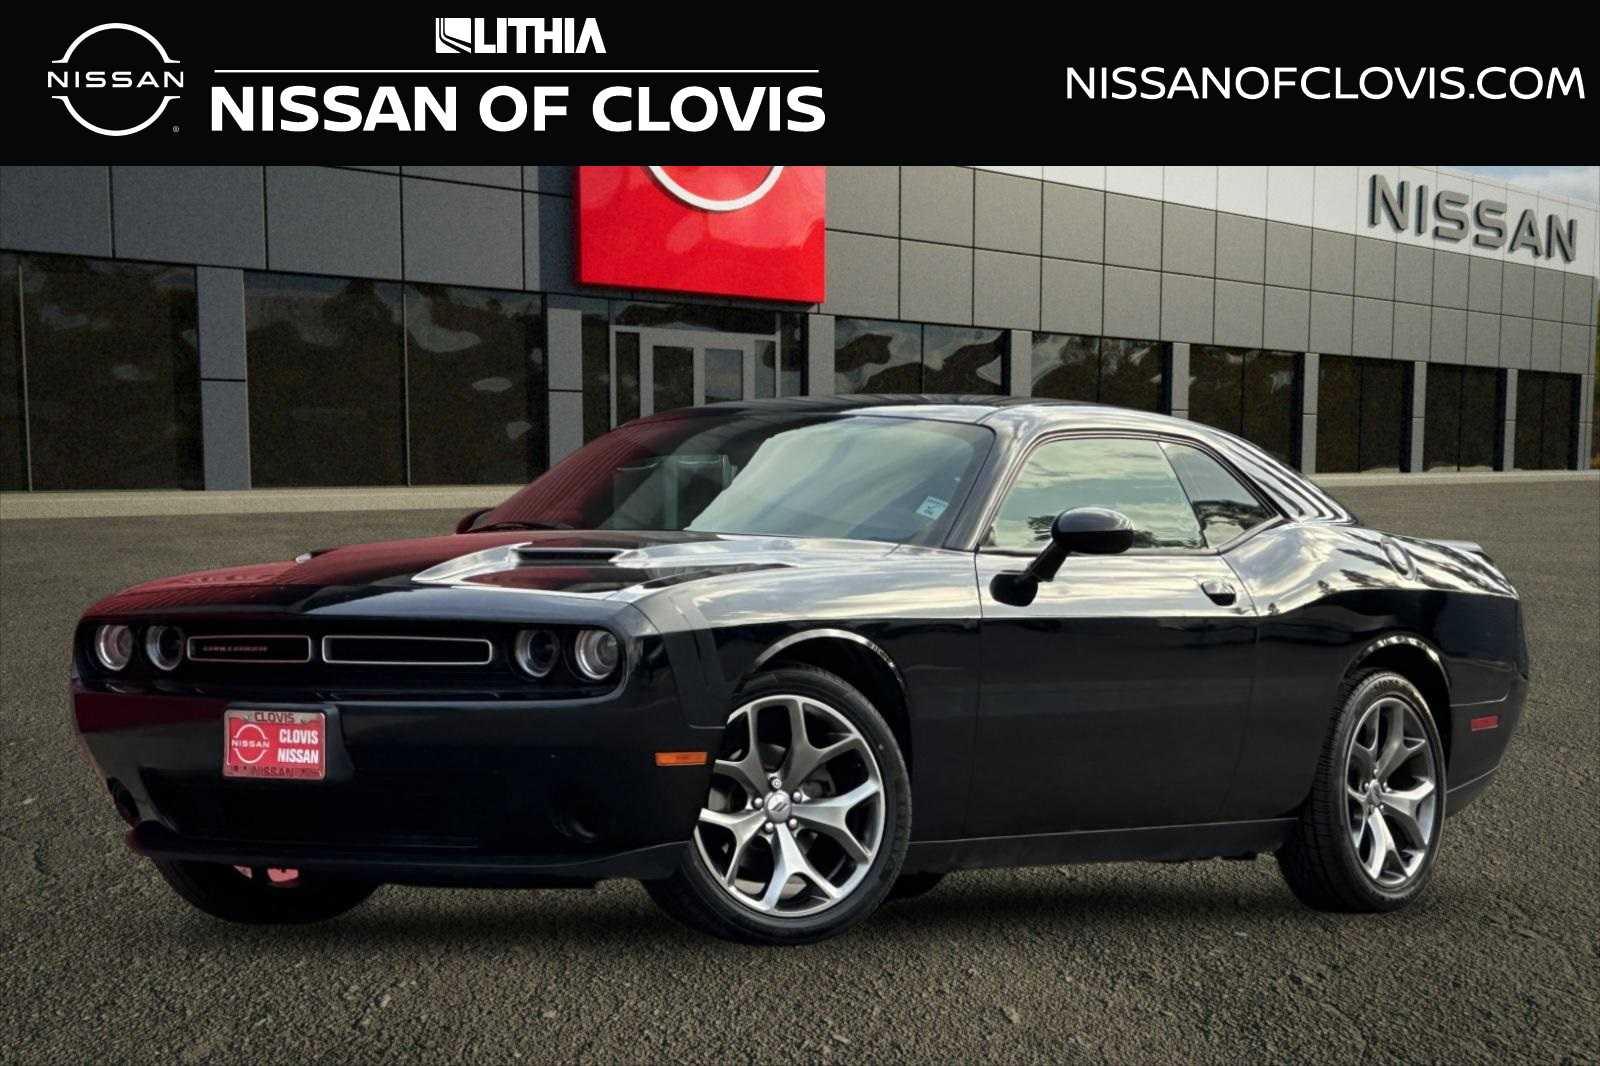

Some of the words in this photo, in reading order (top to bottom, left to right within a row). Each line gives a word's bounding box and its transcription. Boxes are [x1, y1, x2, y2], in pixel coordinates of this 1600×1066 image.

[1368, 174, 1578, 263] NISSAN
[254, 711, 295, 723] CLOVIS
[231, 739, 270, 748] NISSAN
[279, 728, 319, 745] CLOVIS
[277, 748, 319, 764] NISSAN
